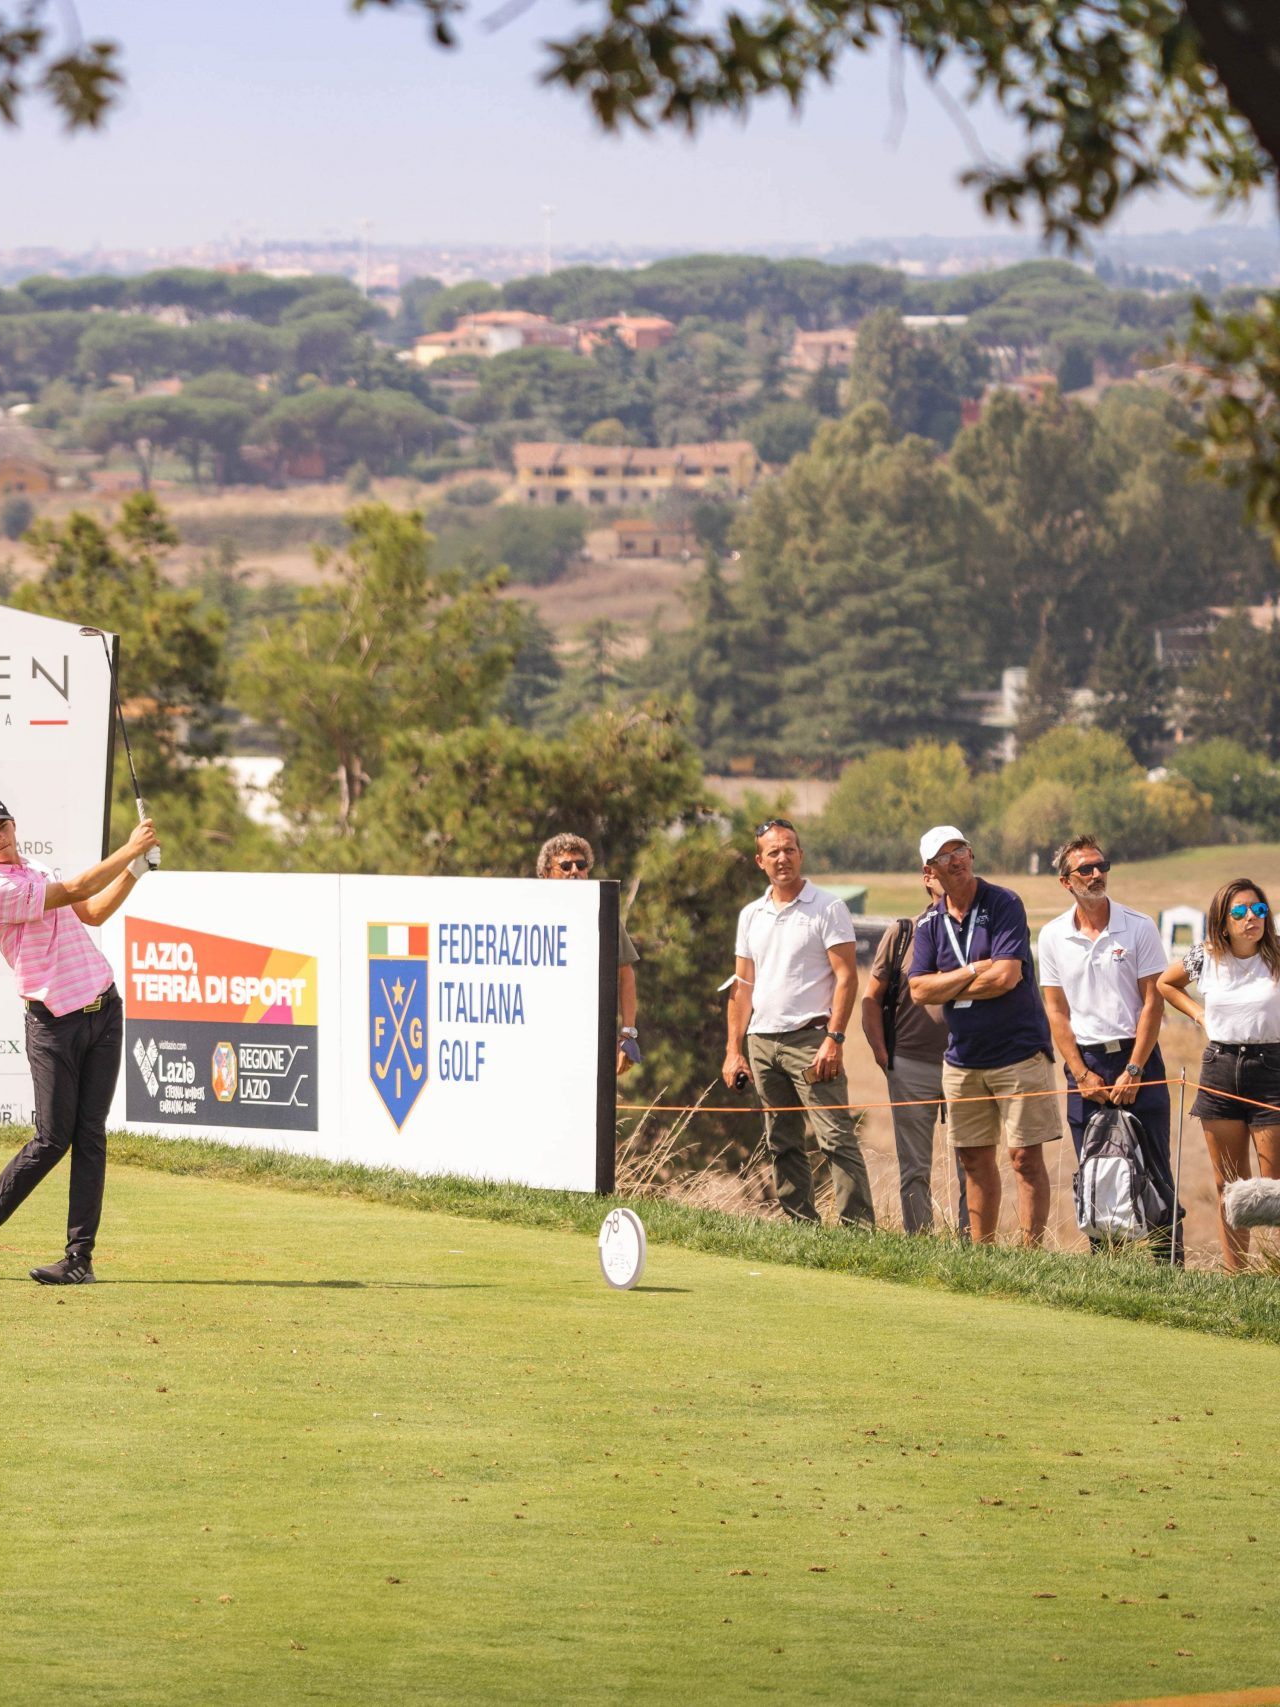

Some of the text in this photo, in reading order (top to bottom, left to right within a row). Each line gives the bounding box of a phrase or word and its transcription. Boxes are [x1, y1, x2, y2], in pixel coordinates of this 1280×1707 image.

[16, 841, 53, 854] ARDS
[132, 942, 198, 974] LAZIO,
[439, 923, 567, 967] FEDERAZIONE
[132, 974, 307, 1007] TERRA DI SPORT
[439, 981, 525, 1025] ITALIANA
[375, 1017, 386, 1047] F
[409, 1017, 423, 1049] G
[240, 1049, 284, 1070] REGIONE
[439, 1039, 485, 1082] GOLF
[240, 1079, 270, 1100] LAZIO
[606, 1211, 619, 1244] 78
